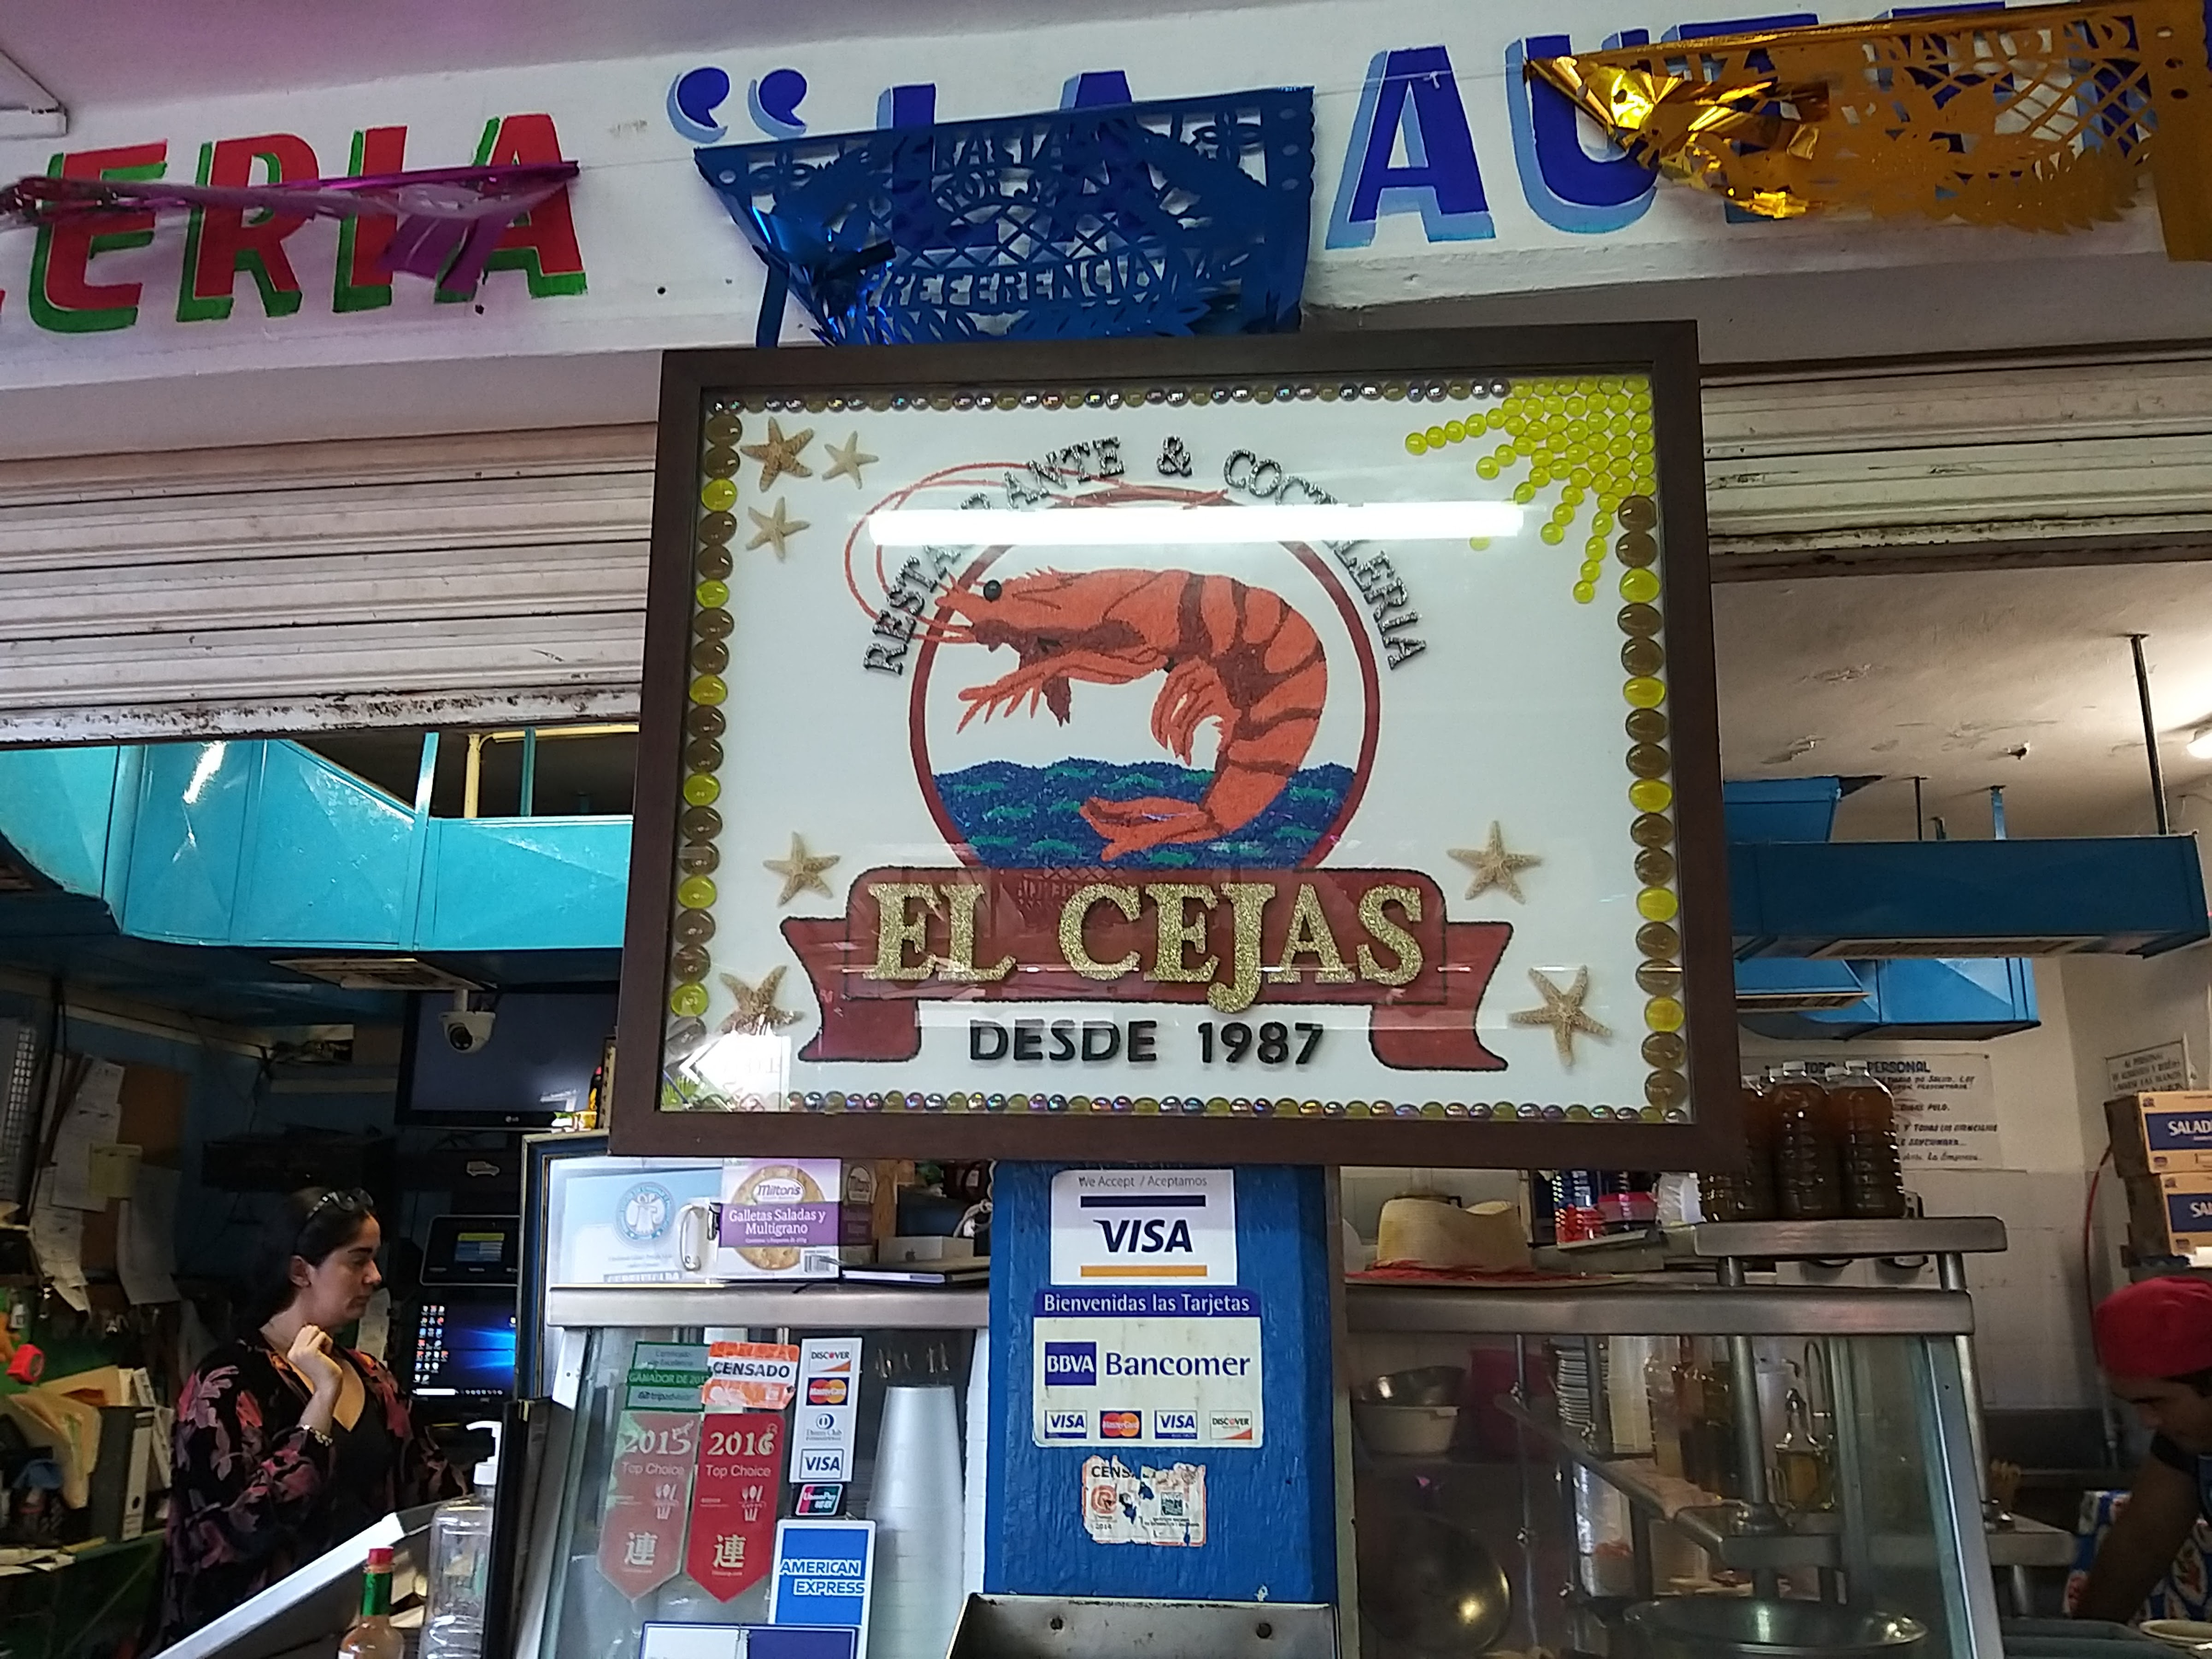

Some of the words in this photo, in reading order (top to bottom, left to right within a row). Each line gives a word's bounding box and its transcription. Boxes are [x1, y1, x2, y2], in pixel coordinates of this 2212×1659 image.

[0, 112, 588, 333] ERIA
[1156, 435, 1193, 477] &
[862, 882, 1017, 982] EL
[1059, 882, 1424, 1013] CEJAS
[969, 1019, 1158, 1063] DESDE
[1197, 1021, 1326, 1066] 1987
[2167, 1119, 2212, 1137] SALAD
[757, 1184, 801, 1196] Milton's
[1078, 1177, 1095, 1187] We
[1098, 1175, 1135, 1188] Accept
[1147, 1175, 1208, 1188] Aceptamos
[729, 1208, 772, 1222] Galletas
[774, 1207, 817, 1221] Saladas
[818, 1211, 826, 1224] y
[745, 1223, 808, 1237] Multigrano
[1092, 1219, 1193, 1253] VISA
[1044, 1293, 1147, 1312] Bienvenidas
[1152, 1293, 1177, 1312] las
[1181, 1293, 1250, 1316] Tarjetas
[811, 1351, 850, 1360] DISCOVER
[713, 1361, 790, 1378] CENSADO
[1047, 1355, 1094, 1373] BBVA
[1106, 1352, 1251, 1377] Bancomer
[629, 1372, 674, 1383] GANADOR
[676, 1374, 687, 1384] DE
[1050, 1414, 1085, 1429] VISA
[1159, 1414, 1195, 1429] VISA
[1212, 1417, 1249, 1426] DISCOVER
[622, 1428, 691, 1455] 2015
[707, 1429, 776, 1456] 2016
[622, 1462, 644, 1476] Top
[645, 1462, 685, 1476] Choice
[706, 1464, 728, 1479] Top
[730, 1464, 772, 1477] Choice
[804, 1457, 841, 1471] VISA
[624, 1531, 658, 1566] 連
[712, 1533, 747, 1569] 連
[779, 1560, 861, 1576] AMERICAN
[794, 1580, 865, 1595] EXPRESS
